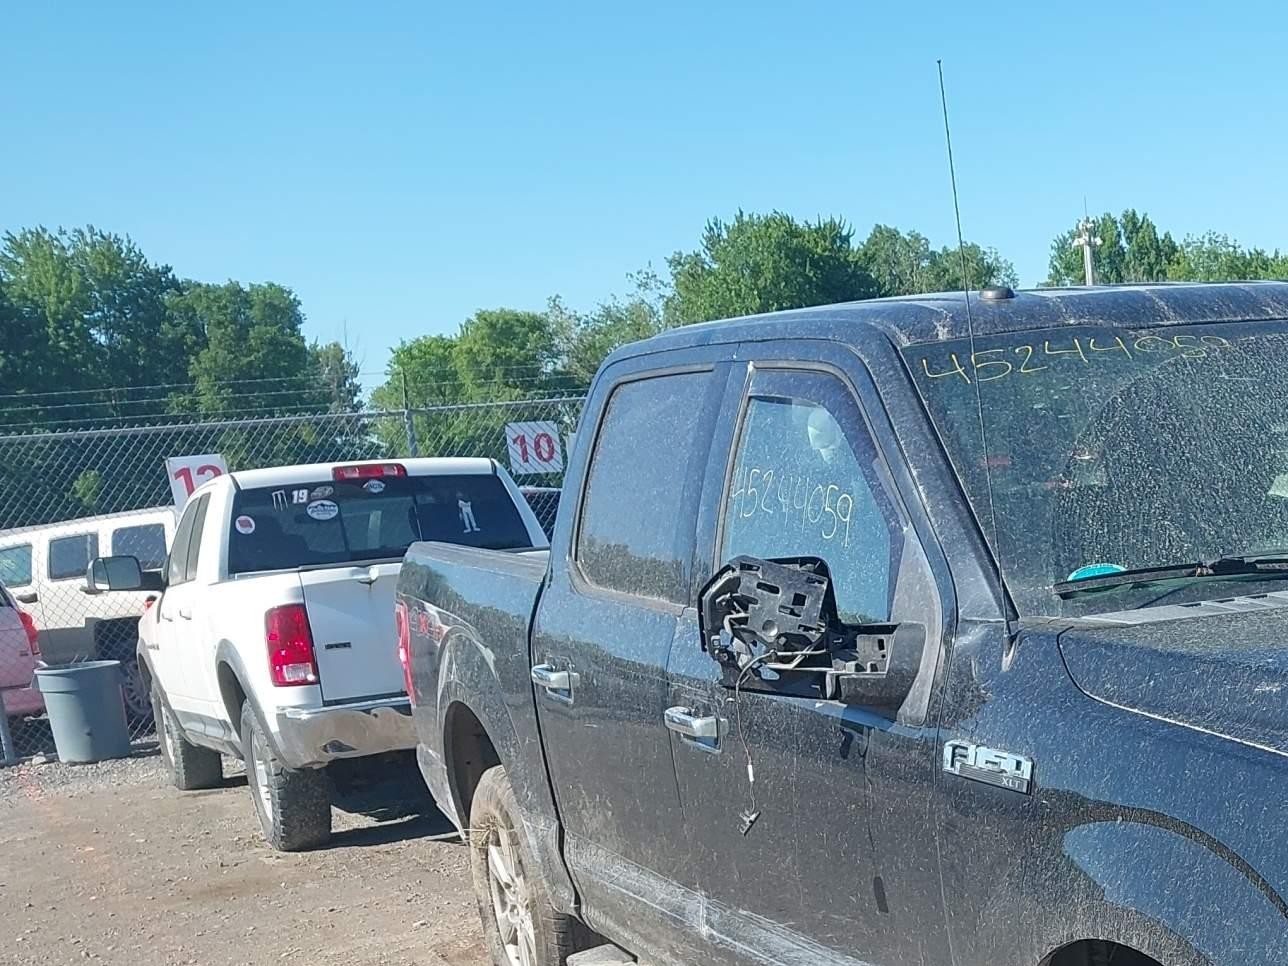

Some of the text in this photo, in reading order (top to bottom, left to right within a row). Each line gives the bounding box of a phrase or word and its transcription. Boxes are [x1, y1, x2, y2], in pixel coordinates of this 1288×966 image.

[512, 432, 555, 463] 10
[291, 488, 308, 504] 19
[732, 466, 853, 548] 45244059
[1001, 776, 1021, 788] XLT
